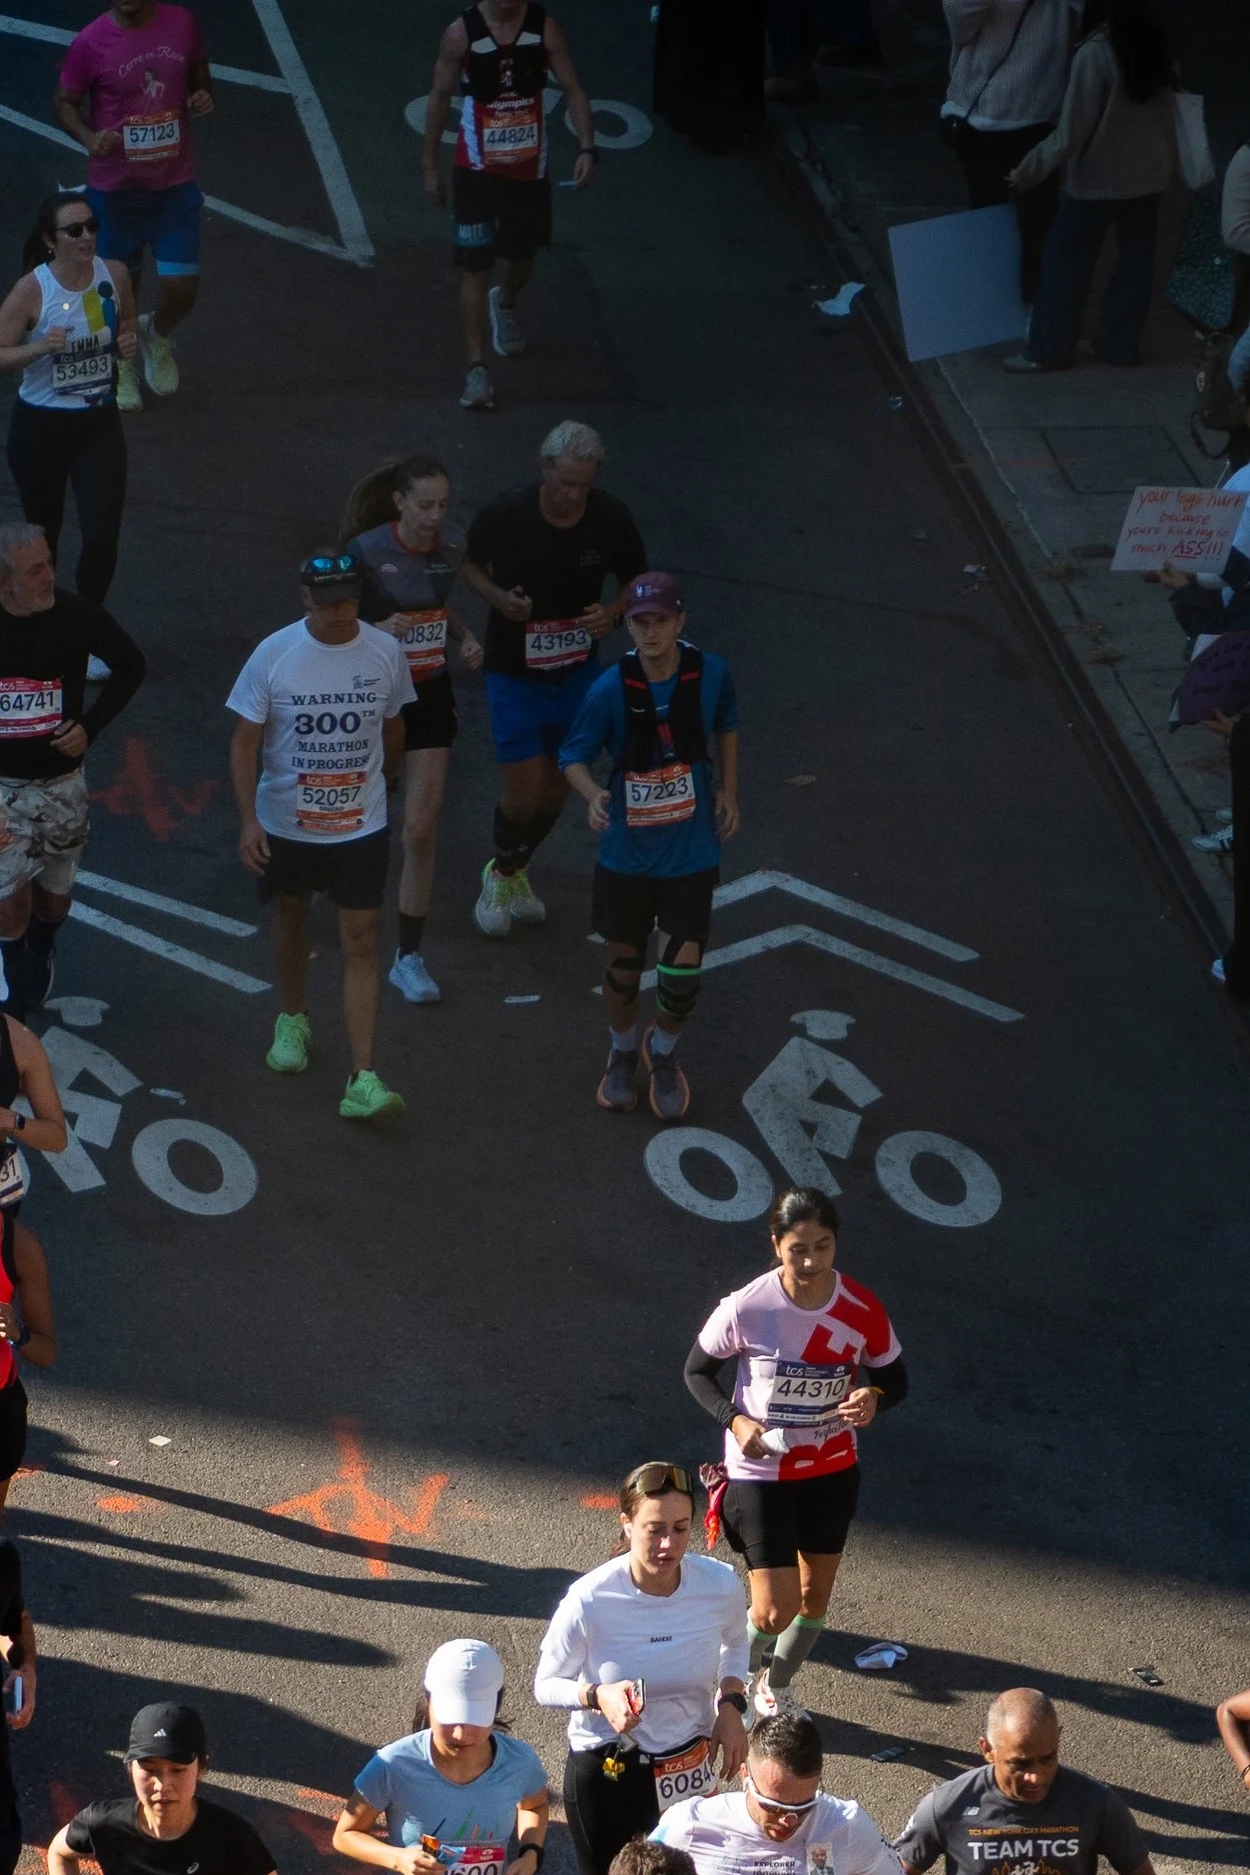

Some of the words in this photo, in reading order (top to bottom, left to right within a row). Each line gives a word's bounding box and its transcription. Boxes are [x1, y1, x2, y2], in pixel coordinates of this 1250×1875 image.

[130, 122, 175, 143] 57123
[487, 122, 535, 144] 44824
[56, 356, 108, 381] 53493
[399, 622, 443, 644] 0832
[531, 630, 587, 651] 43193
[0, 681, 15, 691] tcs
[0, 691, 54, 712] 64741
[291, 692, 377, 706] WARNING
[297, 738, 368, 753] MARATHON
[291, 756, 305, 767] IN
[306, 775, 321, 786] tcs
[631, 777, 688, 802] 57223
[302, 786, 361, 806] 52057
[786, 1365, 804, 1376] tcs
[777, 1379, 846, 1399] 44310
[650, 1635, 673, 1643] BANDIT
[665, 1761, 684, 1773] tcs
[968, 1828, 981, 1836] TCS
[983, 1828, 1000, 1836] NEW
[1023, 1827, 1038, 1835] CITY
[1040, 1826, 1079, 1834] MARATHON
[967, 1839, 1033, 1860] TEAM
[1036, 1839, 1079, 1857] TCS
